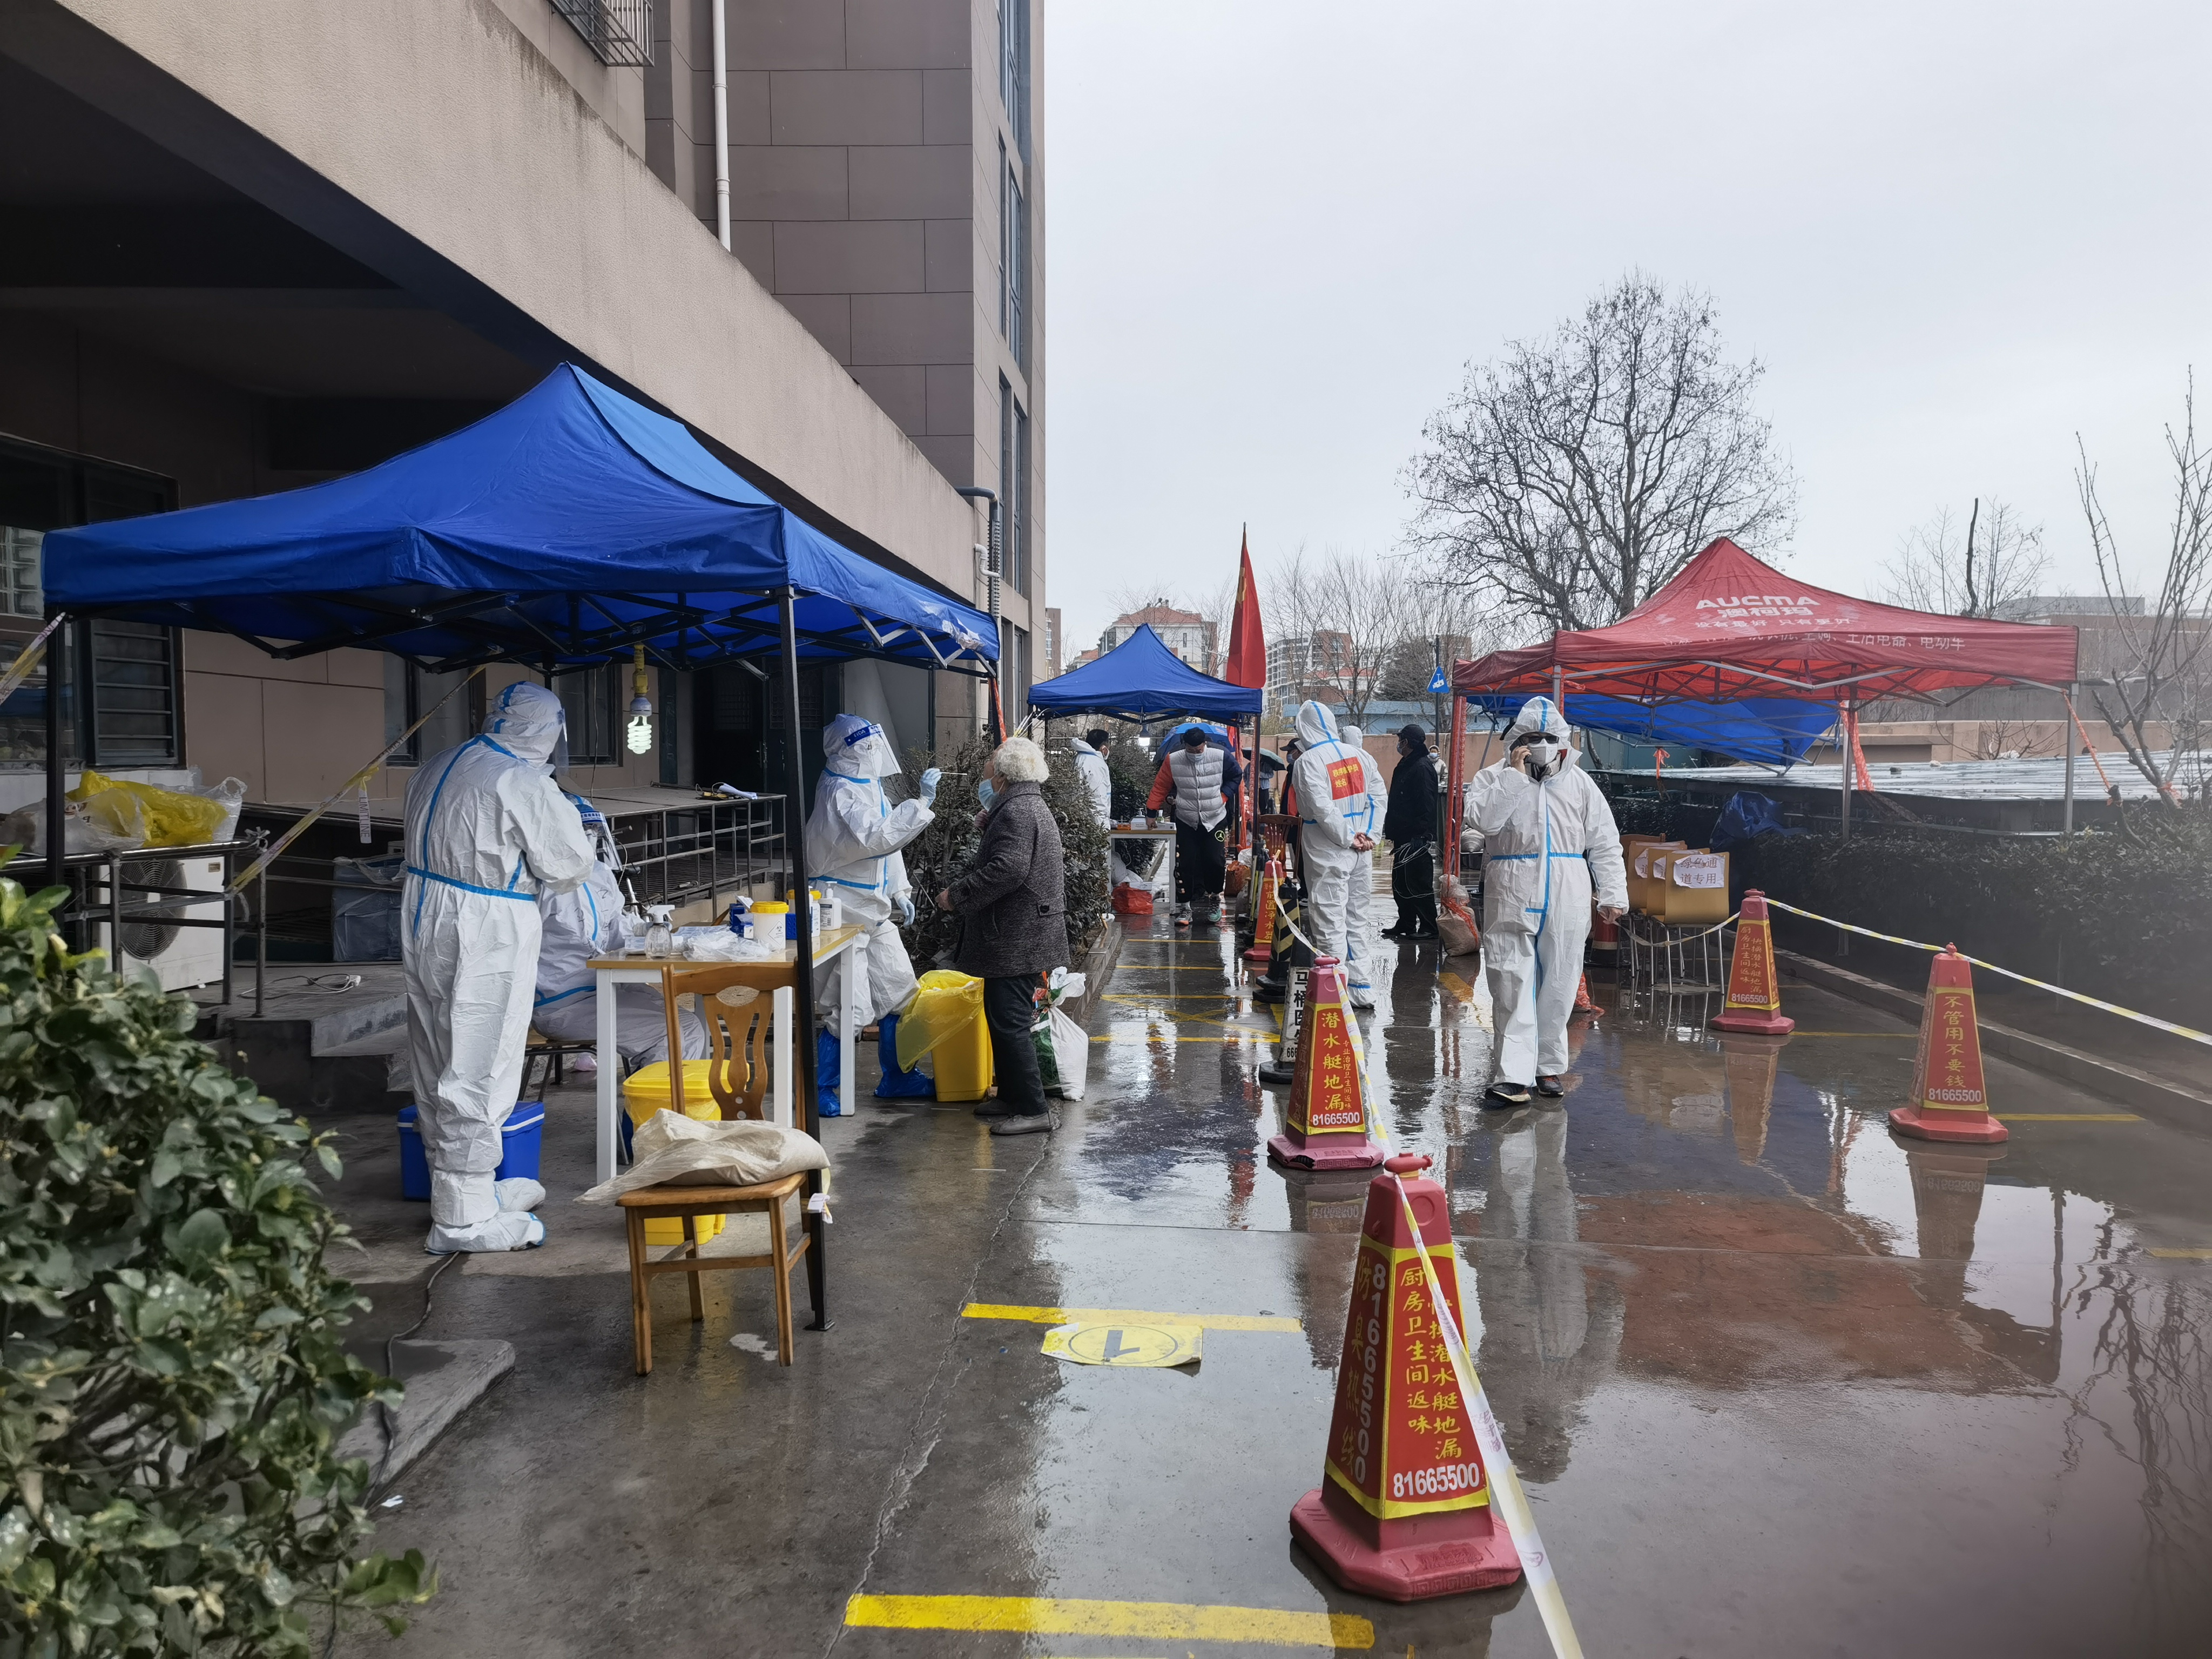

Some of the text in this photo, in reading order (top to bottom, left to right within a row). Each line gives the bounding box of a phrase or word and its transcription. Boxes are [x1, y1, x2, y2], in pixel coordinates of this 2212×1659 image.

[1696, 595, 1820, 609] AUCMA
[1717, 607, 1814, 617] 澳柯玛
[1681, 873, 1716, 885] 道专用
[1731, 993, 1768, 1003] 81665500
[1943, 996, 1966, 1088] 不管用不要钱
[1321, 1013, 1344, 1110] 潜水艇地漏
[1928, 1088, 1981, 1102] 81665500
[1313, 1112, 1360, 1126] 81665500
[1401, 1266, 1432, 1434] 厨房卫生间返味
[1355, 1263, 1386, 1484] 81665500
[1393, 1462, 1480, 1498] 81665500
